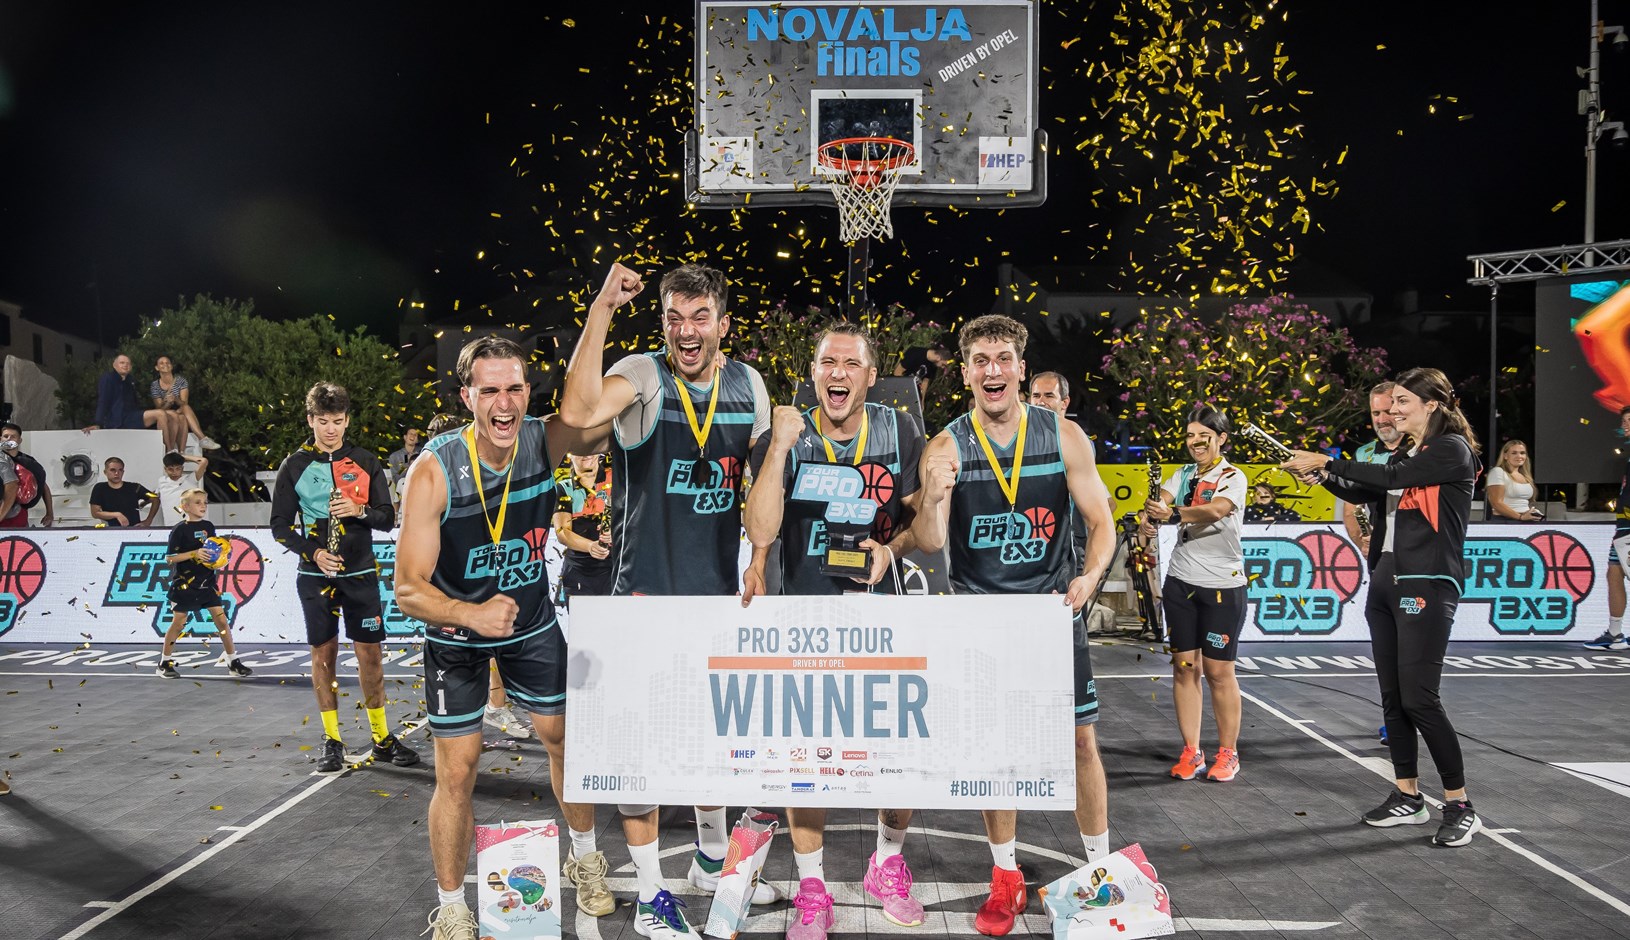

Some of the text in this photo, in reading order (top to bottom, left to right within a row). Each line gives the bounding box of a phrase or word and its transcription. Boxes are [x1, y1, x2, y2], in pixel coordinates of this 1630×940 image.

[748, 9, 972, 41] NOVALJA
[817, 41, 921, 76] Finals
[938, 29, 1019, 82] DRIVEN BY OPEL
[995, 154, 1025, 168] HEP
[805, 467, 840, 476] TOUR
[798, 474, 859, 498] PRO
[829, 502, 874, 519] 3X3
[976, 516, 1007, 524] TOUR
[973, 523, 1026, 543] PRO
[470, 546, 524, 574] PRO
[475, 544, 507, 556] TOUR
[1463, 548, 1501, 556] OUR
[118, 563, 173, 592] PR
[1244, 559, 1303, 588] RO
[1264, 597, 1334, 619] 3X3
[1499, 597, 1568, 619] 3X3
[738, 627, 893, 653] PRO 3X3 TOUR
[792, 659, 845, 668] DRIVEN BY OPEL
[437, 689, 447, 715] 1
[709, 673, 930, 738] WINNER
[740, 750, 755, 758] HEP
[582, 775, 647, 791] #BUDIPRO
[950, 778, 1055, 797] #BUDIDIOPRIČE
